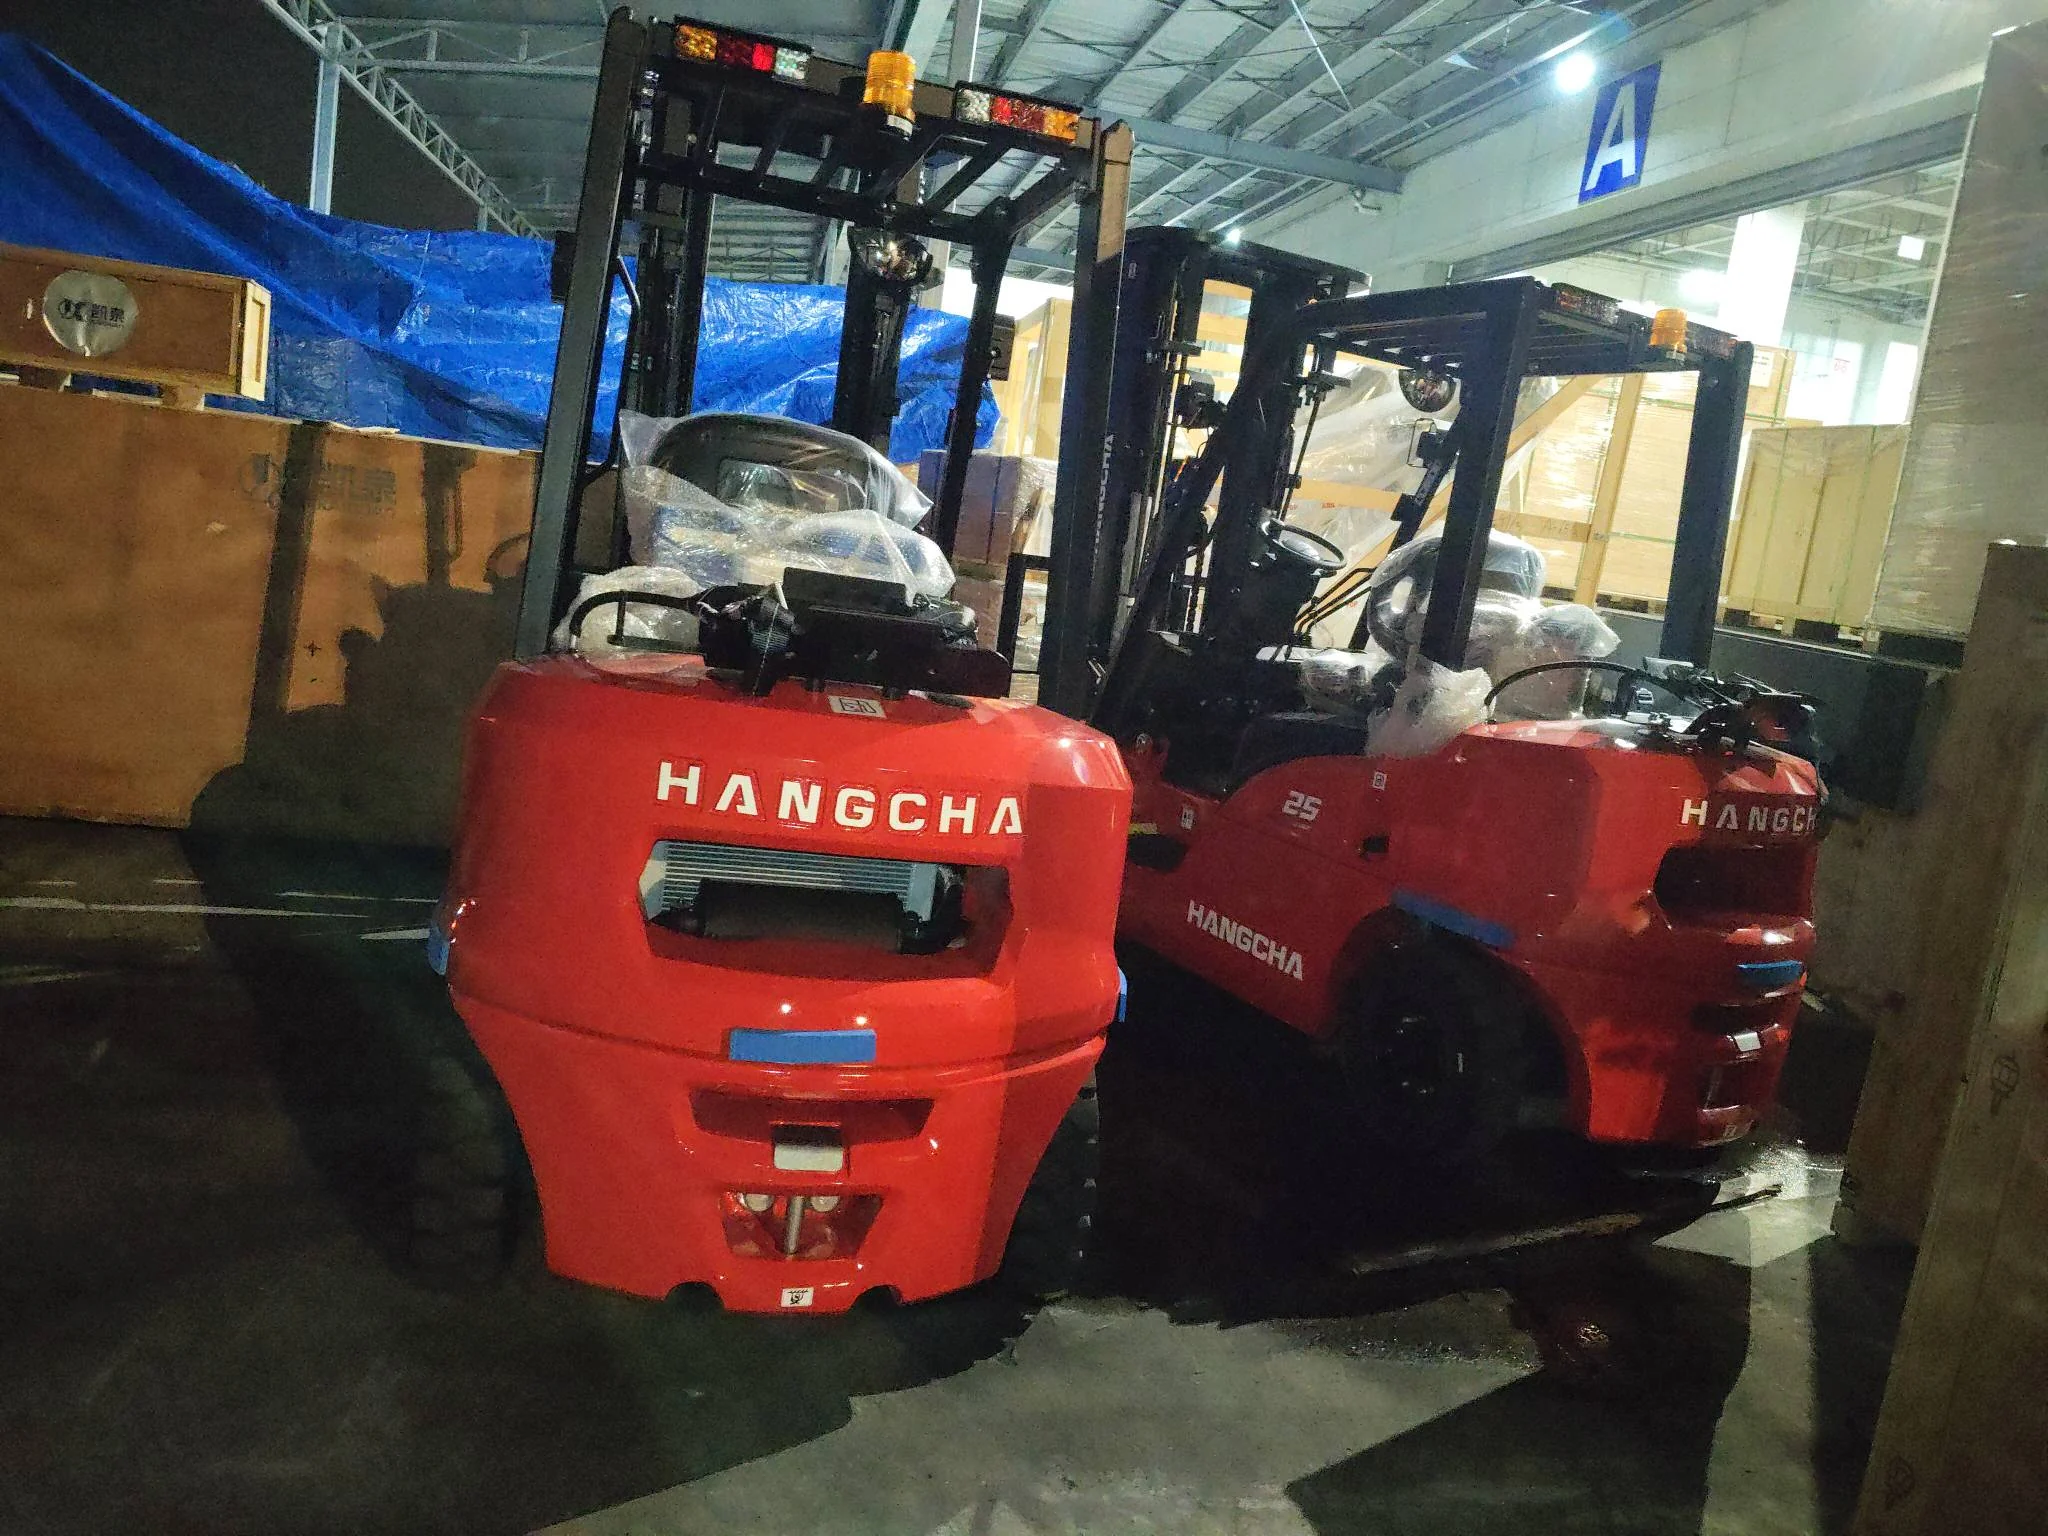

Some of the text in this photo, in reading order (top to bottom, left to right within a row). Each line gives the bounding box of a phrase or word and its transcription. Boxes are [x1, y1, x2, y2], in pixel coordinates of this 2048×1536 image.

[1585, 82, 1636, 191] A
[656, 761, 1023, 834] HANGCHA
[1282, 791, 1322, 821] 25
[1187, 900, 1304, 980] HANGCHA
